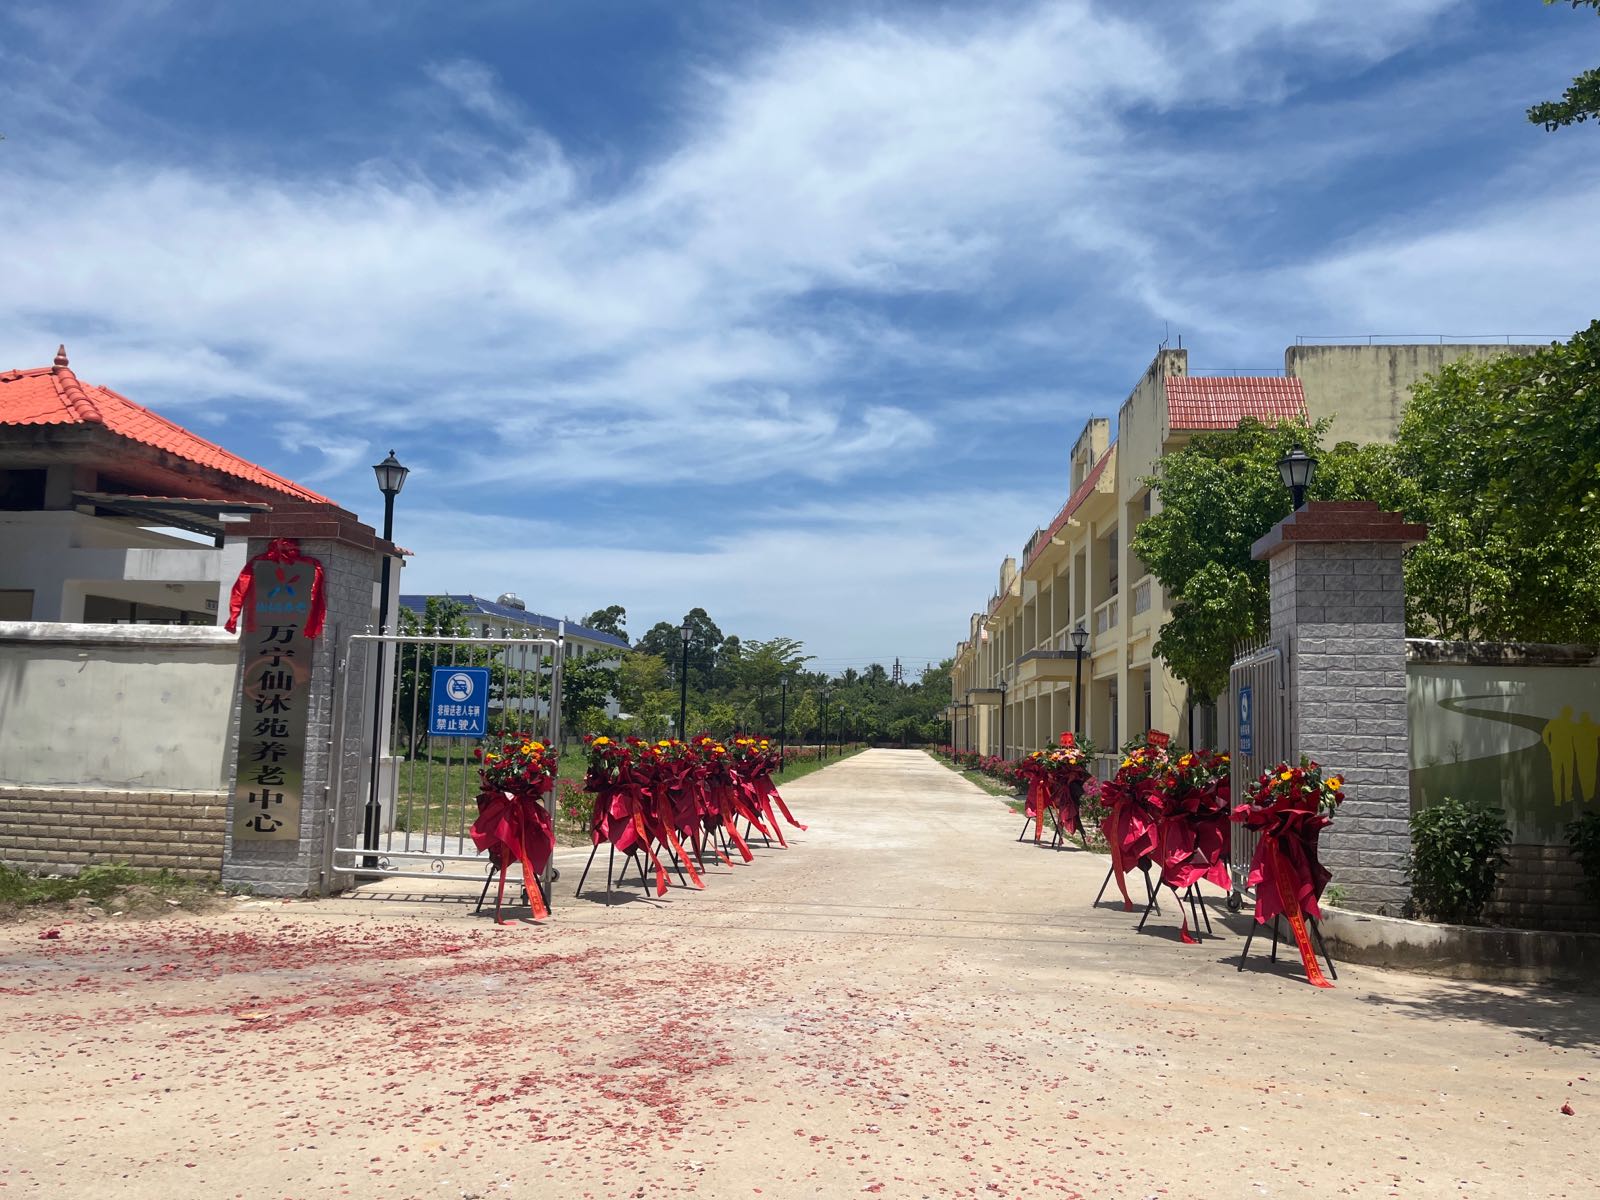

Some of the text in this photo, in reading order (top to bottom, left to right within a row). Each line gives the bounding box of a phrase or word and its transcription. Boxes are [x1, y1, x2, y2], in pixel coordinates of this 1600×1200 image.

[245, 623, 298, 833] 万宁仙沐苑养老中心
[436, 718, 480, 731] 禁止驶入
